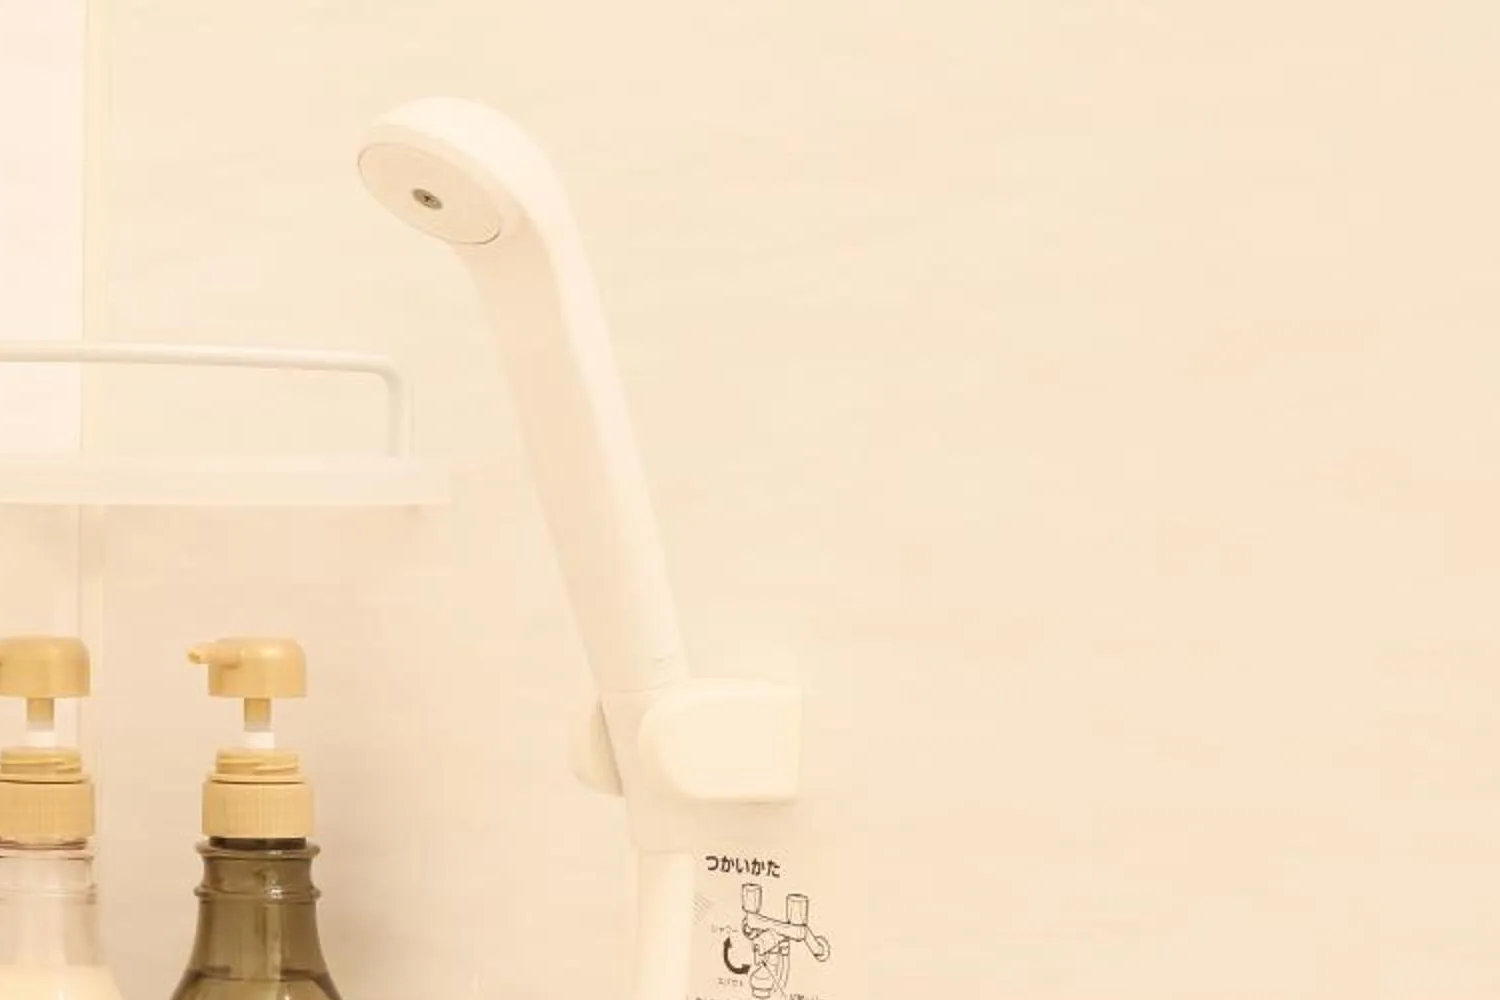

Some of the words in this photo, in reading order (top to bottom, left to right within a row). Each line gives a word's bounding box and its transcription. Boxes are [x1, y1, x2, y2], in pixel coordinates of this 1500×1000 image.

[705, 855, 781, 878] つかいかた
